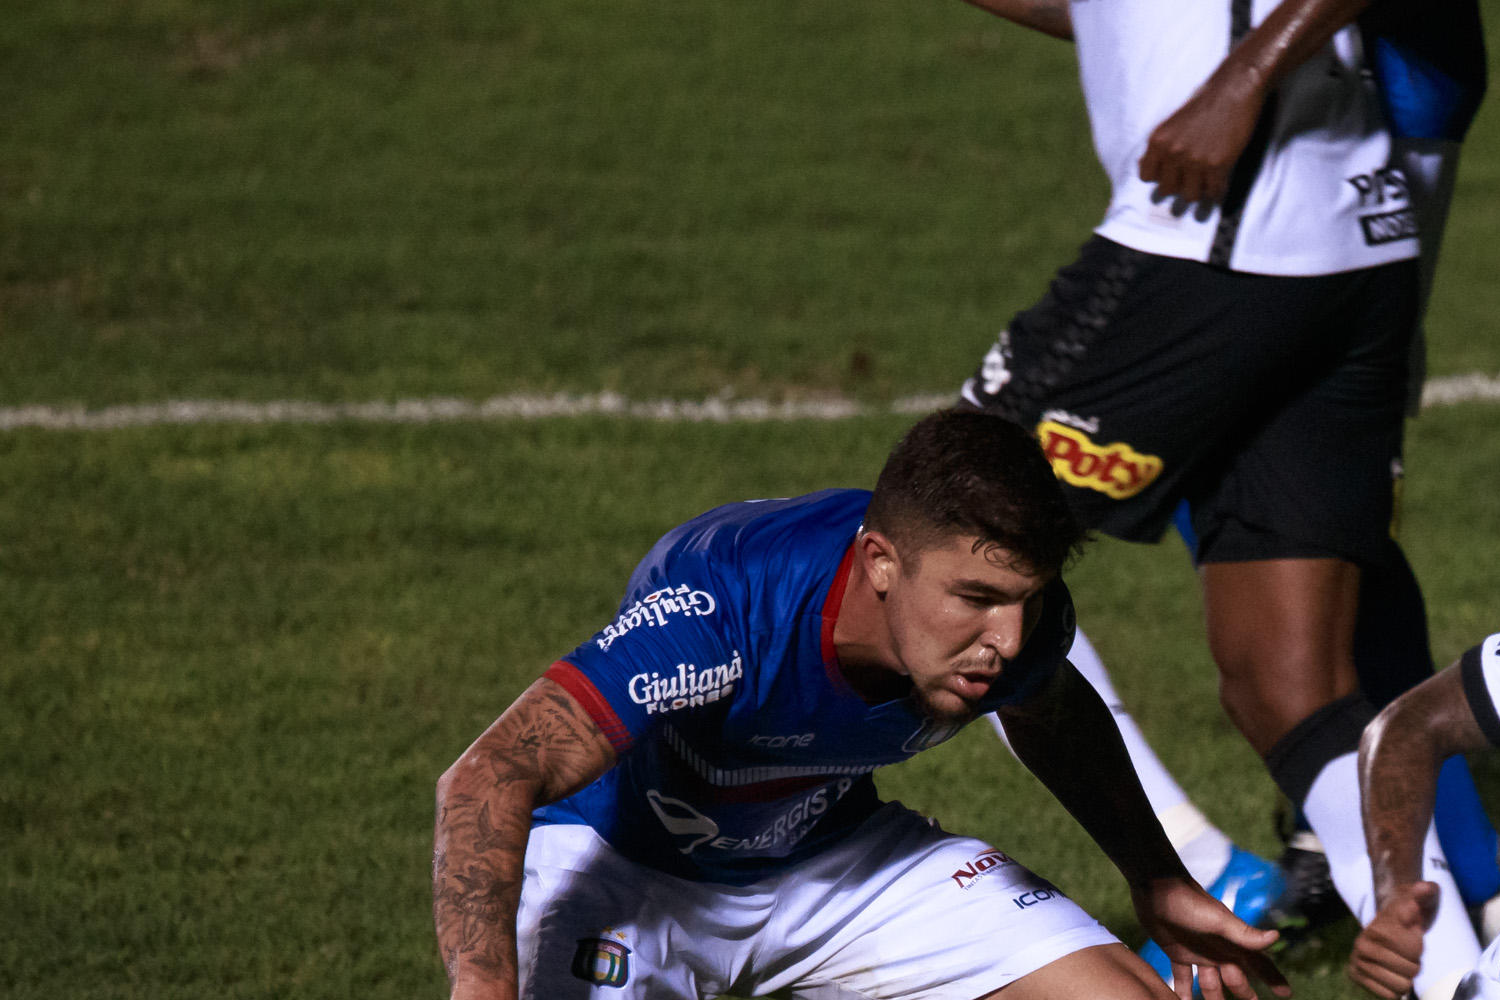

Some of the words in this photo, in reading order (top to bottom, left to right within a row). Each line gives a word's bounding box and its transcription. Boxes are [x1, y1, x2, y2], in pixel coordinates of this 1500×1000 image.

[597, 583, 716, 651] Giuliana
[628, 656, 743, 705] Giuliana
[709, 788, 829, 851] ENERGIS
